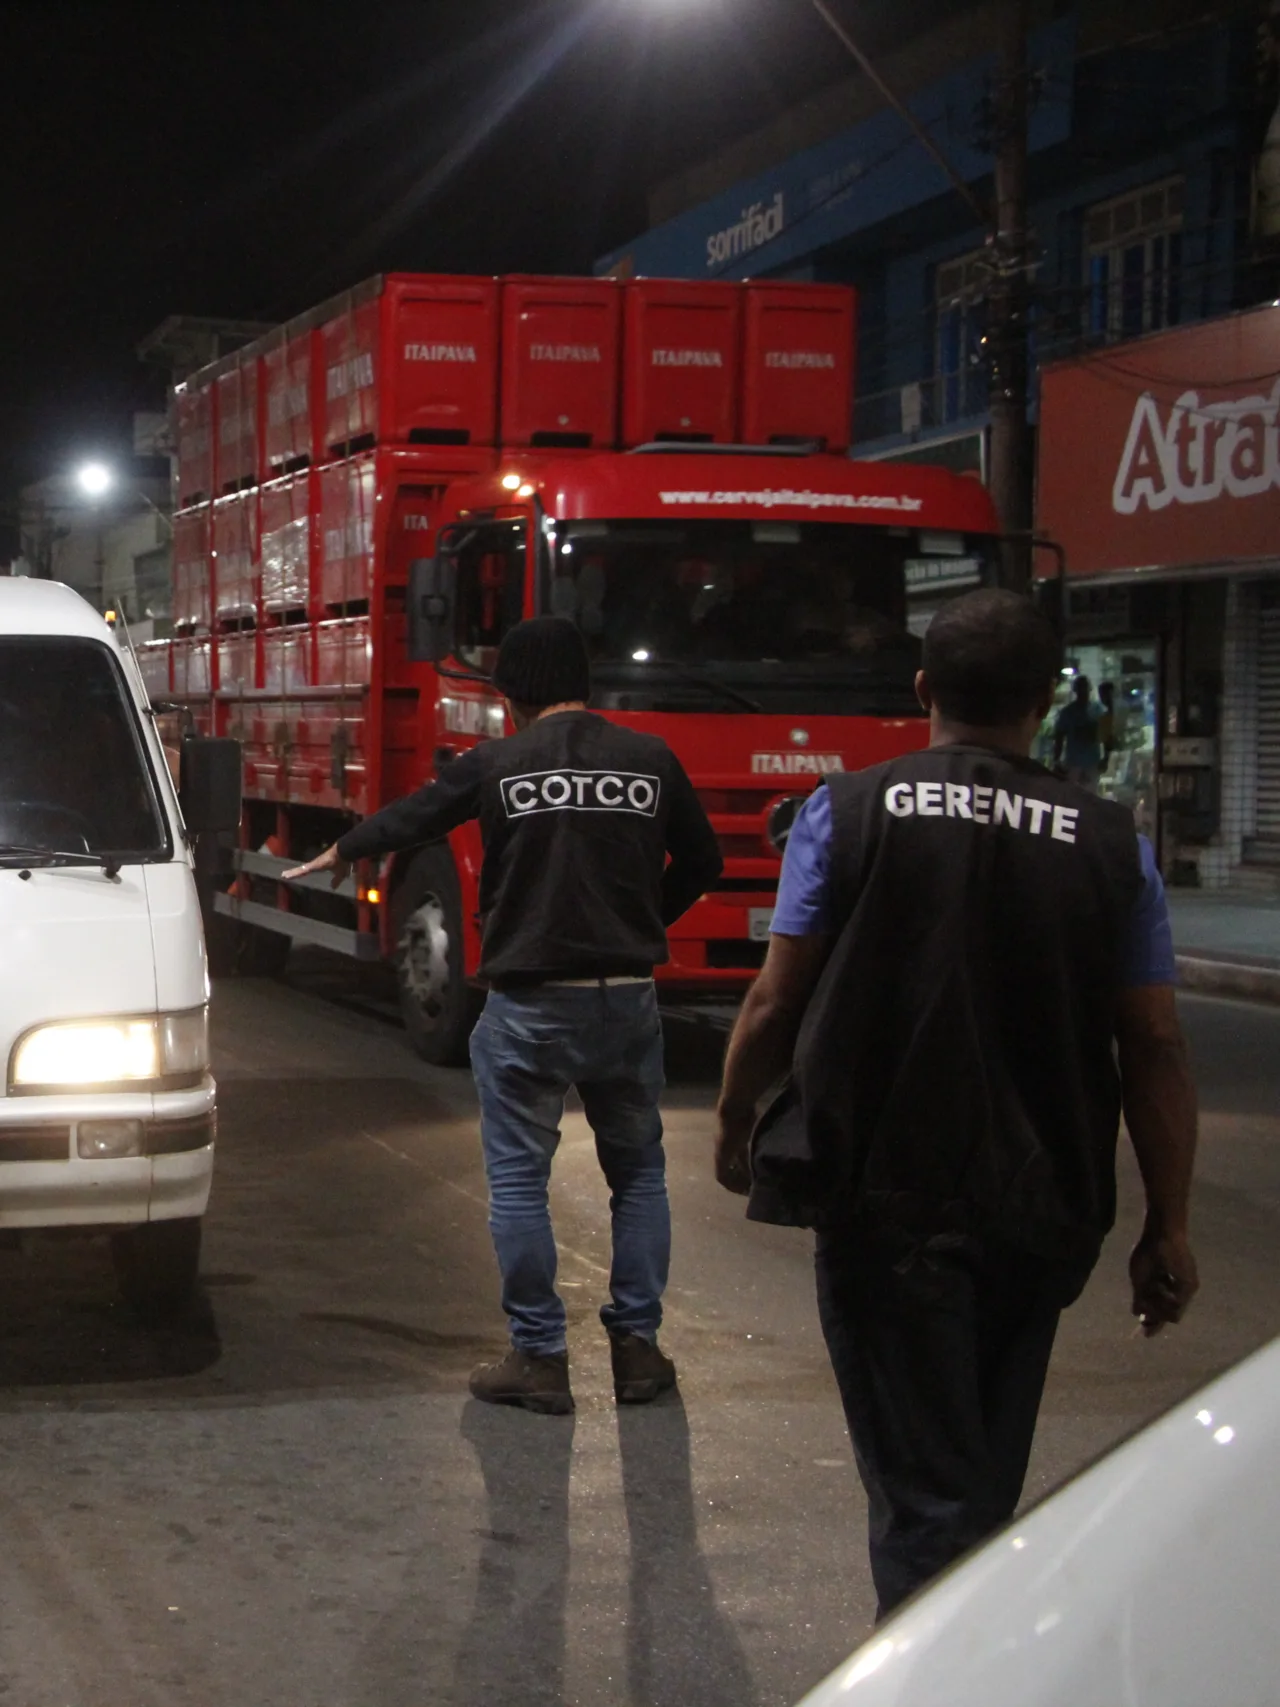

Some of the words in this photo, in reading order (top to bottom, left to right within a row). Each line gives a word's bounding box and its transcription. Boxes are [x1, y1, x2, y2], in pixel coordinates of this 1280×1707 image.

[404, 344, 476, 362] ITAIPAVA
[530, 345, 601, 362] ITAIPAVA
[651, 350, 723, 367] ITAIPAVA
[765, 353, 834, 368] ITAIPAVA
[1113, 378, 1280, 514] Atra
[404, 515, 428, 530] ITA
[751, 754, 845, 774] ITAIPAVA
[508, 775, 654, 811] COTCO
[885, 782, 1079, 844] GERENTE
